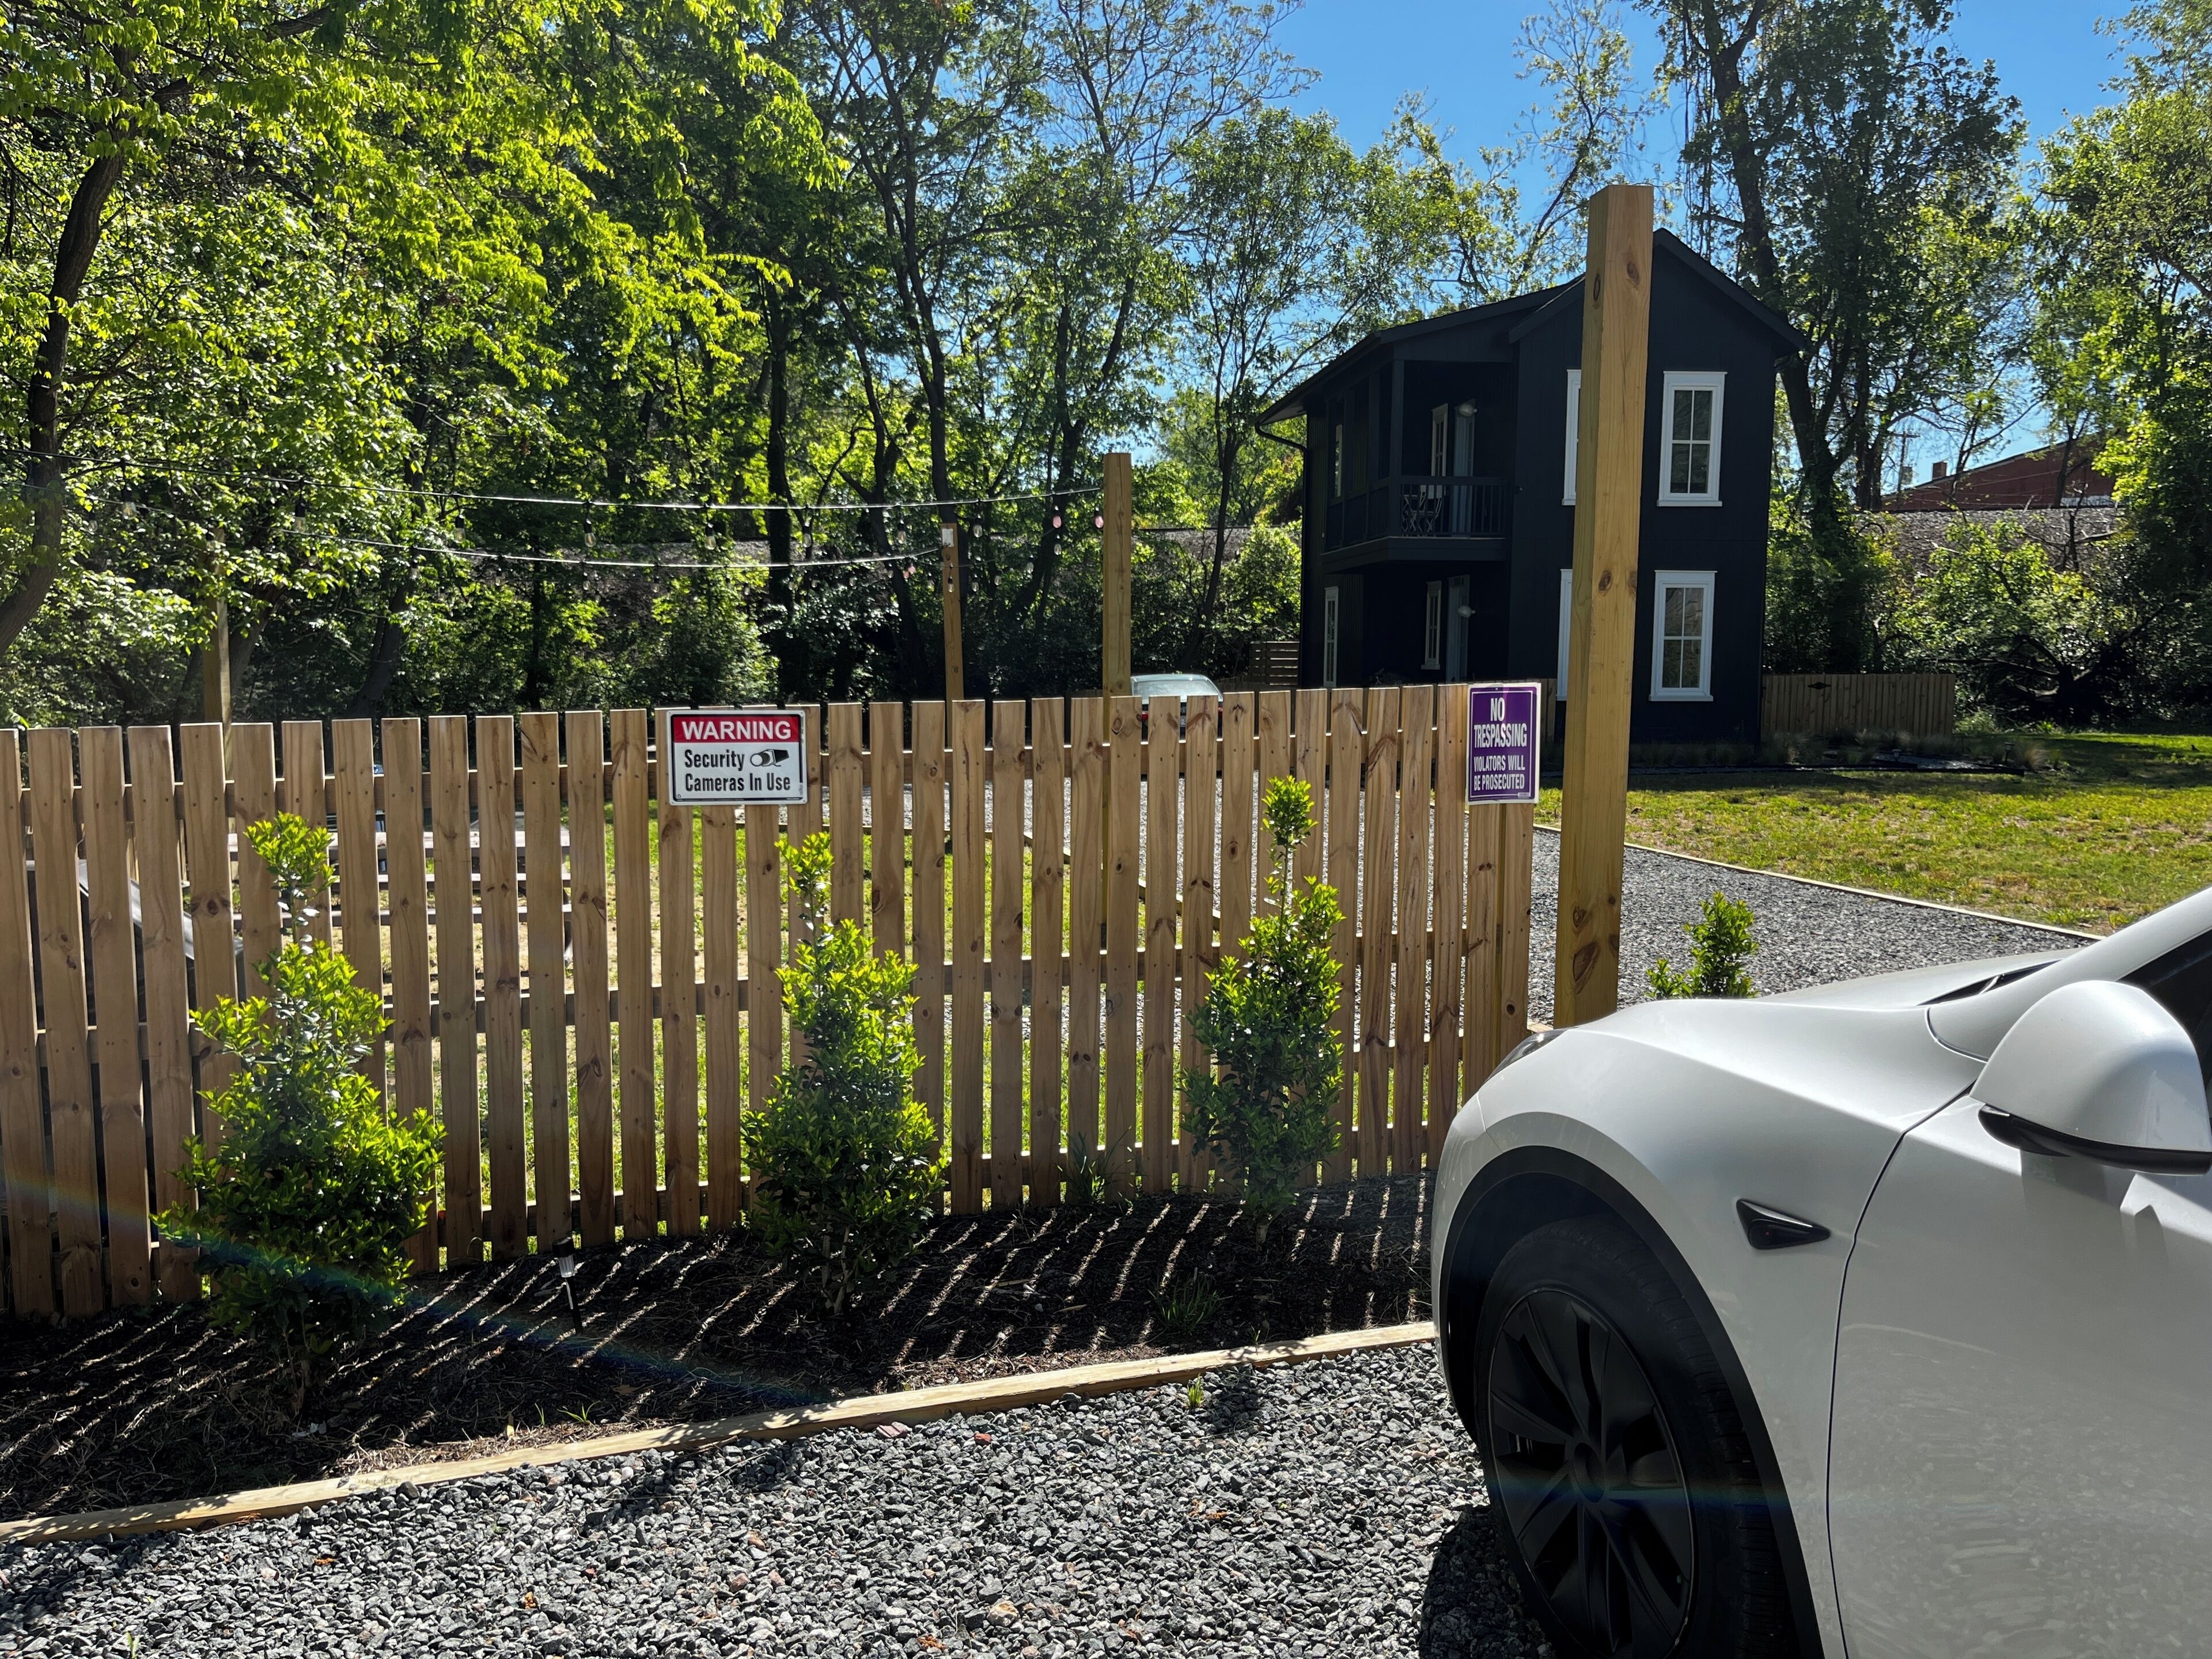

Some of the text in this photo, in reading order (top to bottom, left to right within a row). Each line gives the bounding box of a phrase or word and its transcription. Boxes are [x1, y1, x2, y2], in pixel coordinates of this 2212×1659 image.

[1490, 697, 1505, 722] NO
[681, 721, 791, 740] WARNING
[1474, 723, 1527, 748] TRESPASSING
[684, 749, 745, 771] Security
[1474, 755, 1525, 772] VIOLATORS WILL
[685, 773, 745, 791] Cameras
[749, 772, 762, 791] In
[767, 772, 790, 791] Use
[1474, 774, 1525, 791] BE PROSECUTED
